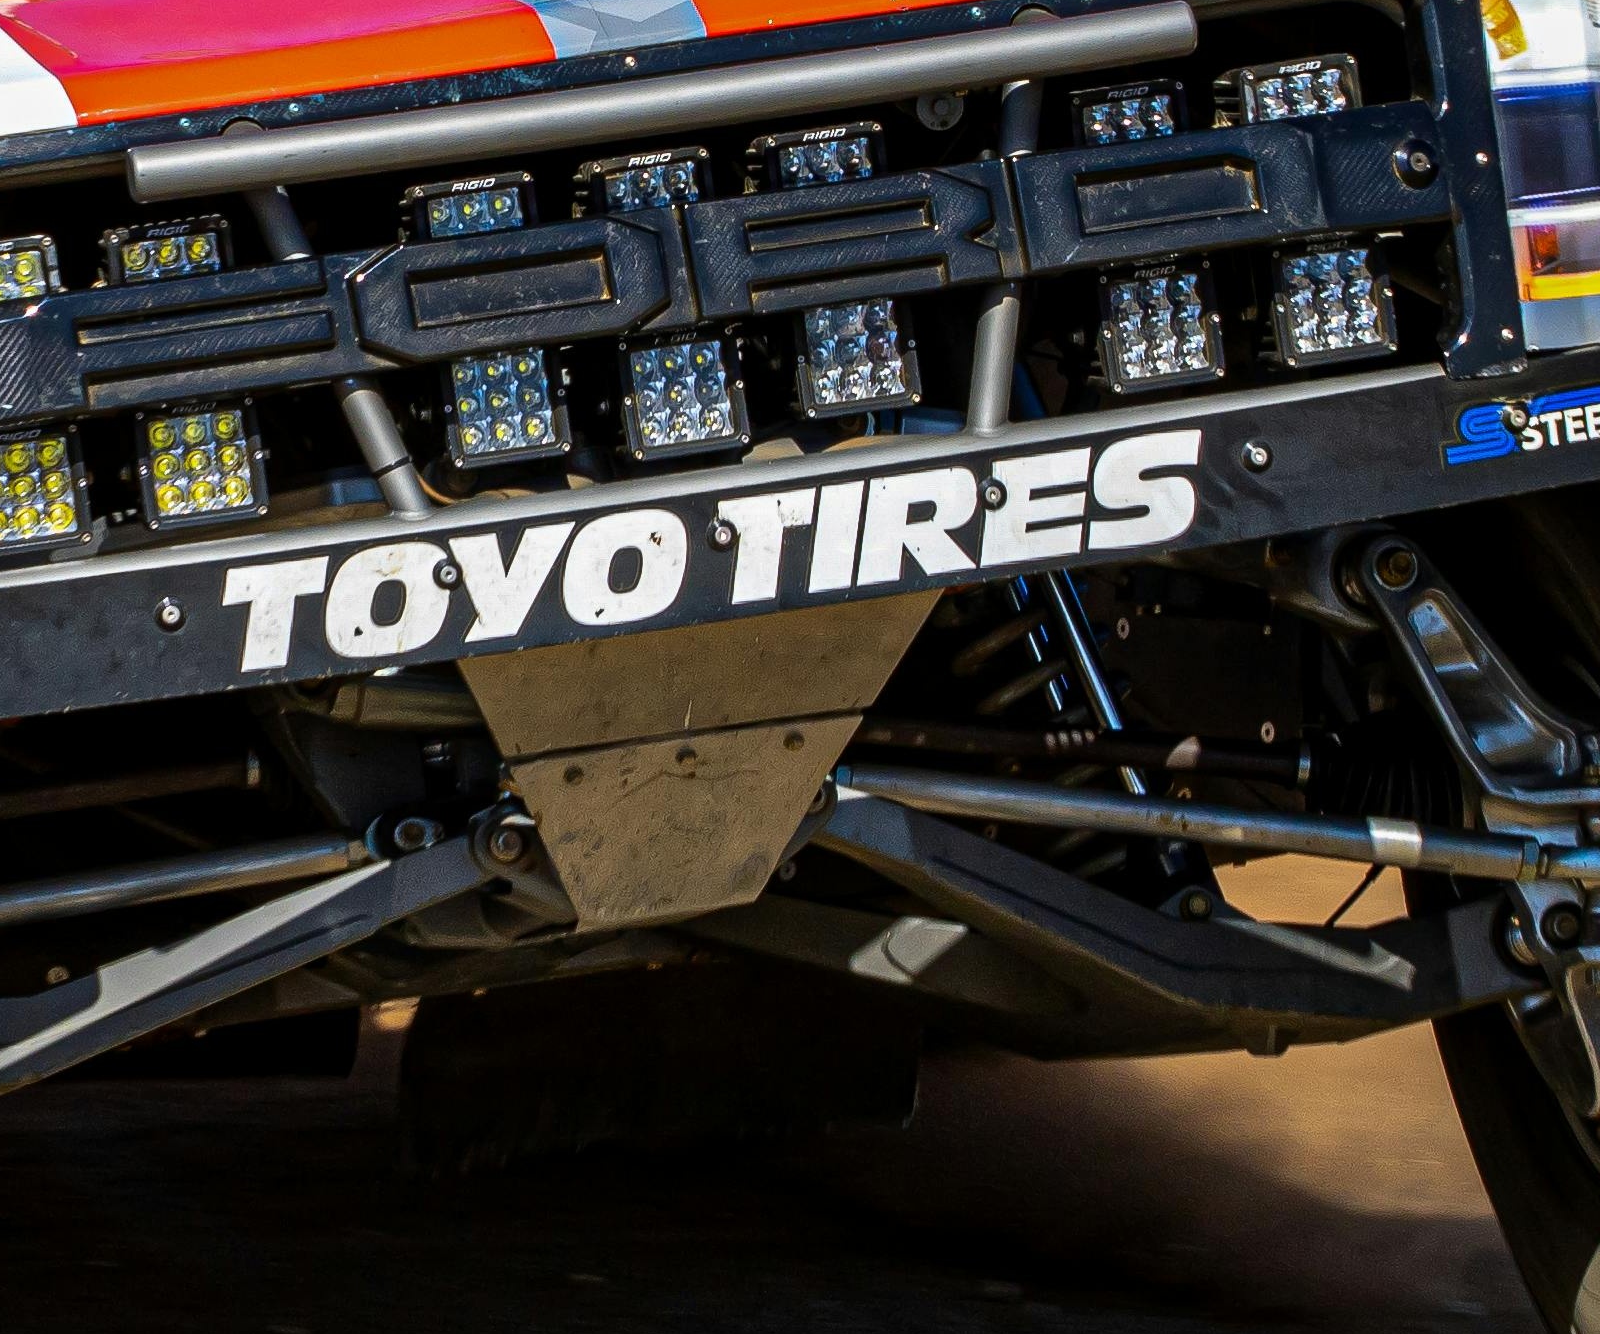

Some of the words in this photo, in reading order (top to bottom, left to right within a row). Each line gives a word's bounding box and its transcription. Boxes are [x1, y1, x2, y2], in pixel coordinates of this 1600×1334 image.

[1106, 85, 1150, 100] RIGID
[802, 127, 847, 143] RIGID
[627, 152, 672, 168] RIGID
[451, 177, 496, 193] RIGID
[221, 508, 690, 673] TOYO
[715, 429, 1201, 605] TIRES
